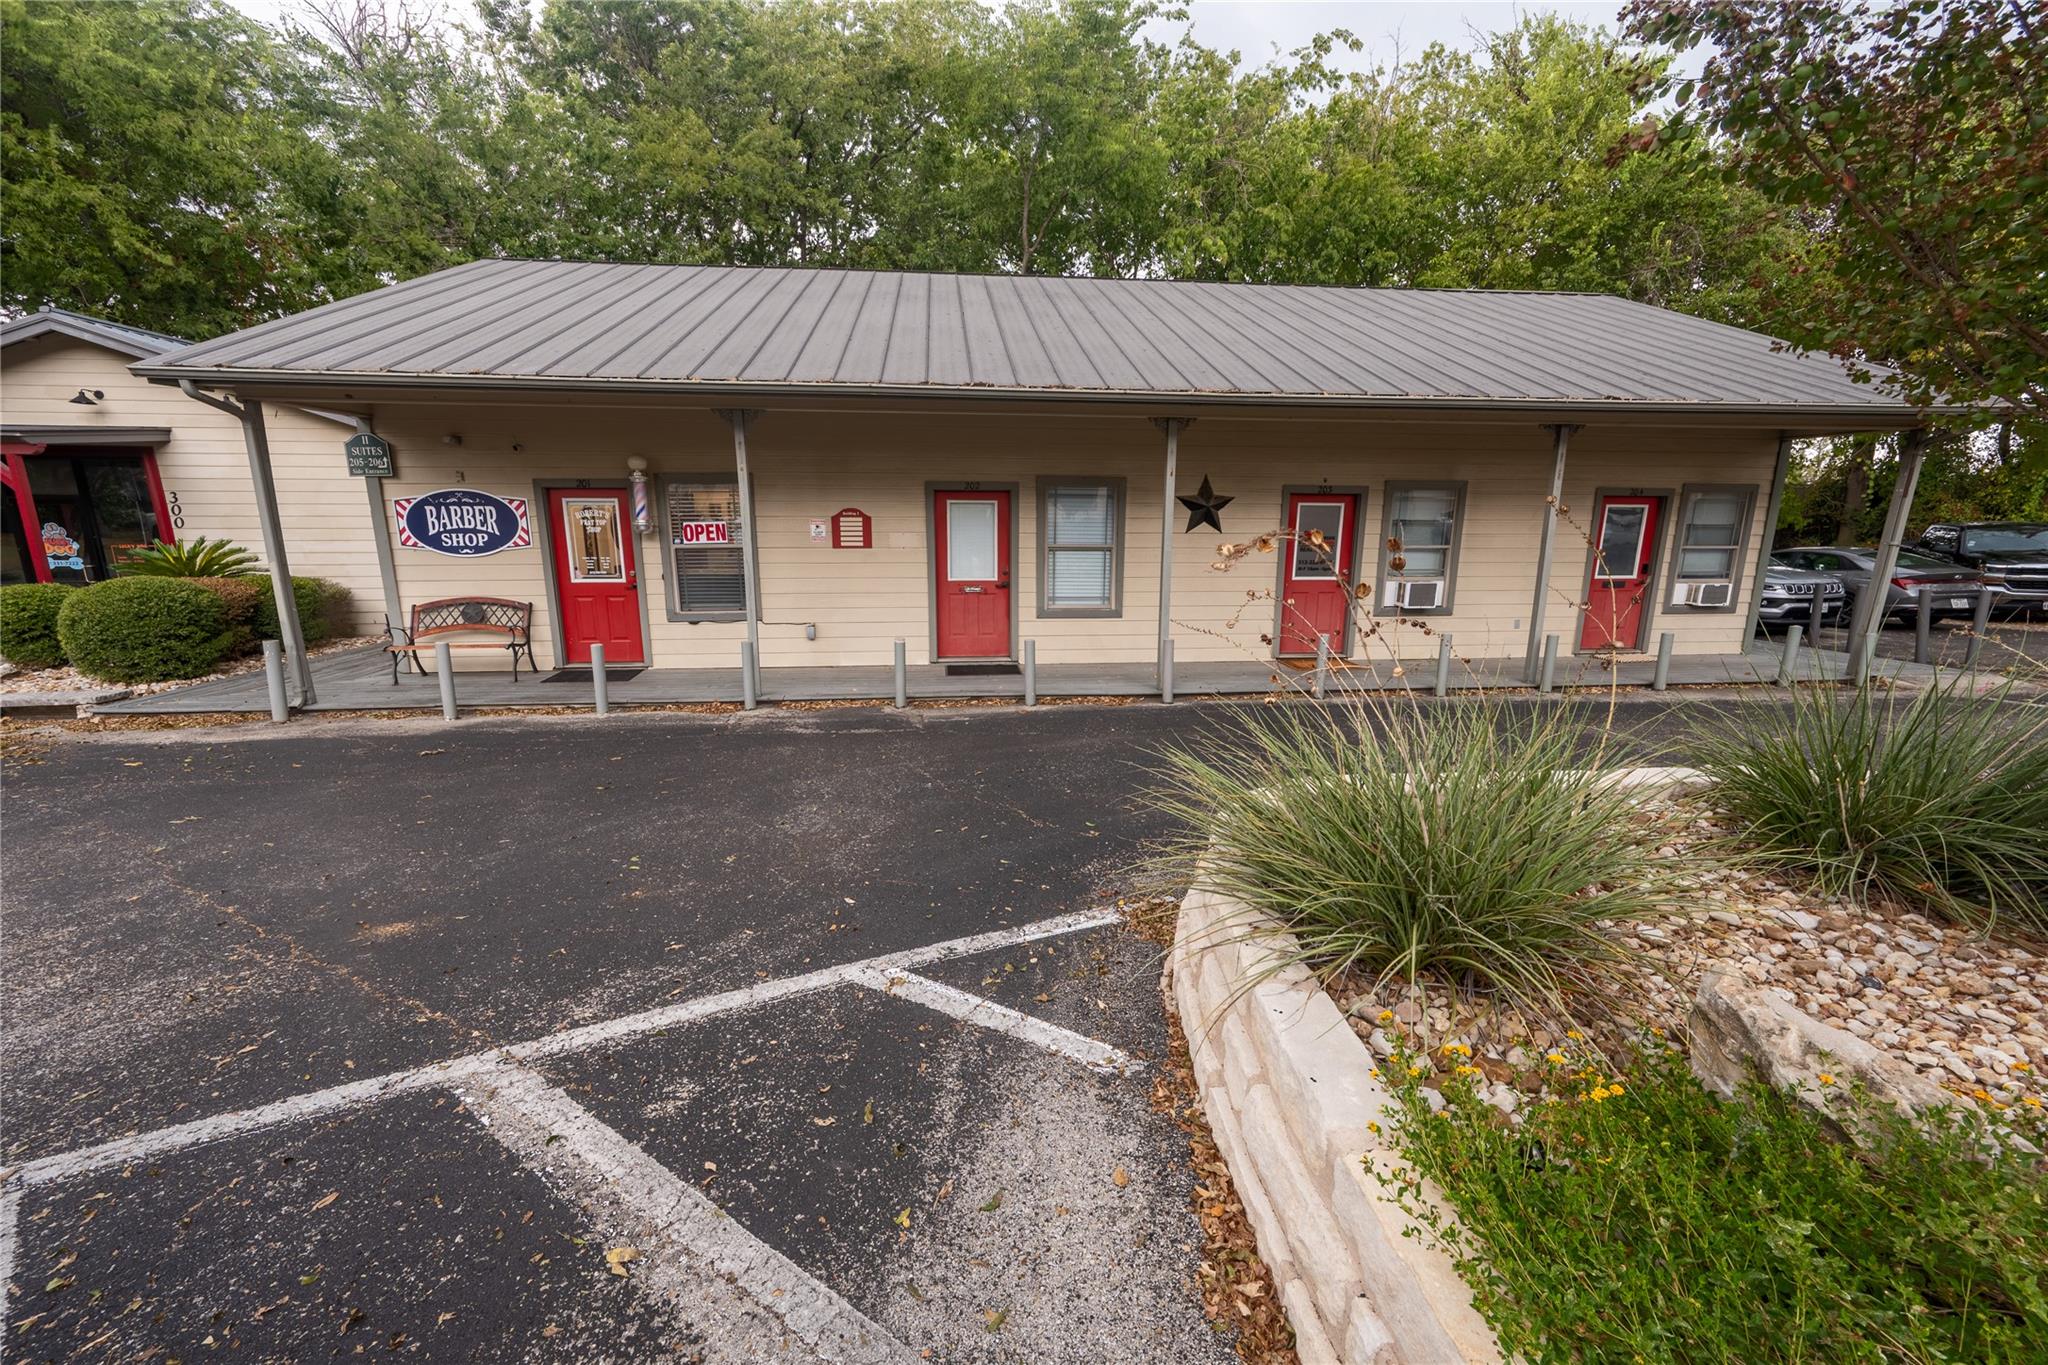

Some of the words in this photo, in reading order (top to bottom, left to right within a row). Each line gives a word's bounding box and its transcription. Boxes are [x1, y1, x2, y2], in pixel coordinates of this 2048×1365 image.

[351, 447, 383, 456] SUITES
[576, 479, 591, 488] 201
[964, 481, 980, 490] 202
[169, 491, 185, 529] 300
[575, 509, 610, 520] ROBERT'S
[424, 505, 500, 536] BARBER
[683, 523, 727, 542] OPEN
[441, 533, 489, 547] SHOP
[45, 543, 76, 555] DOG
